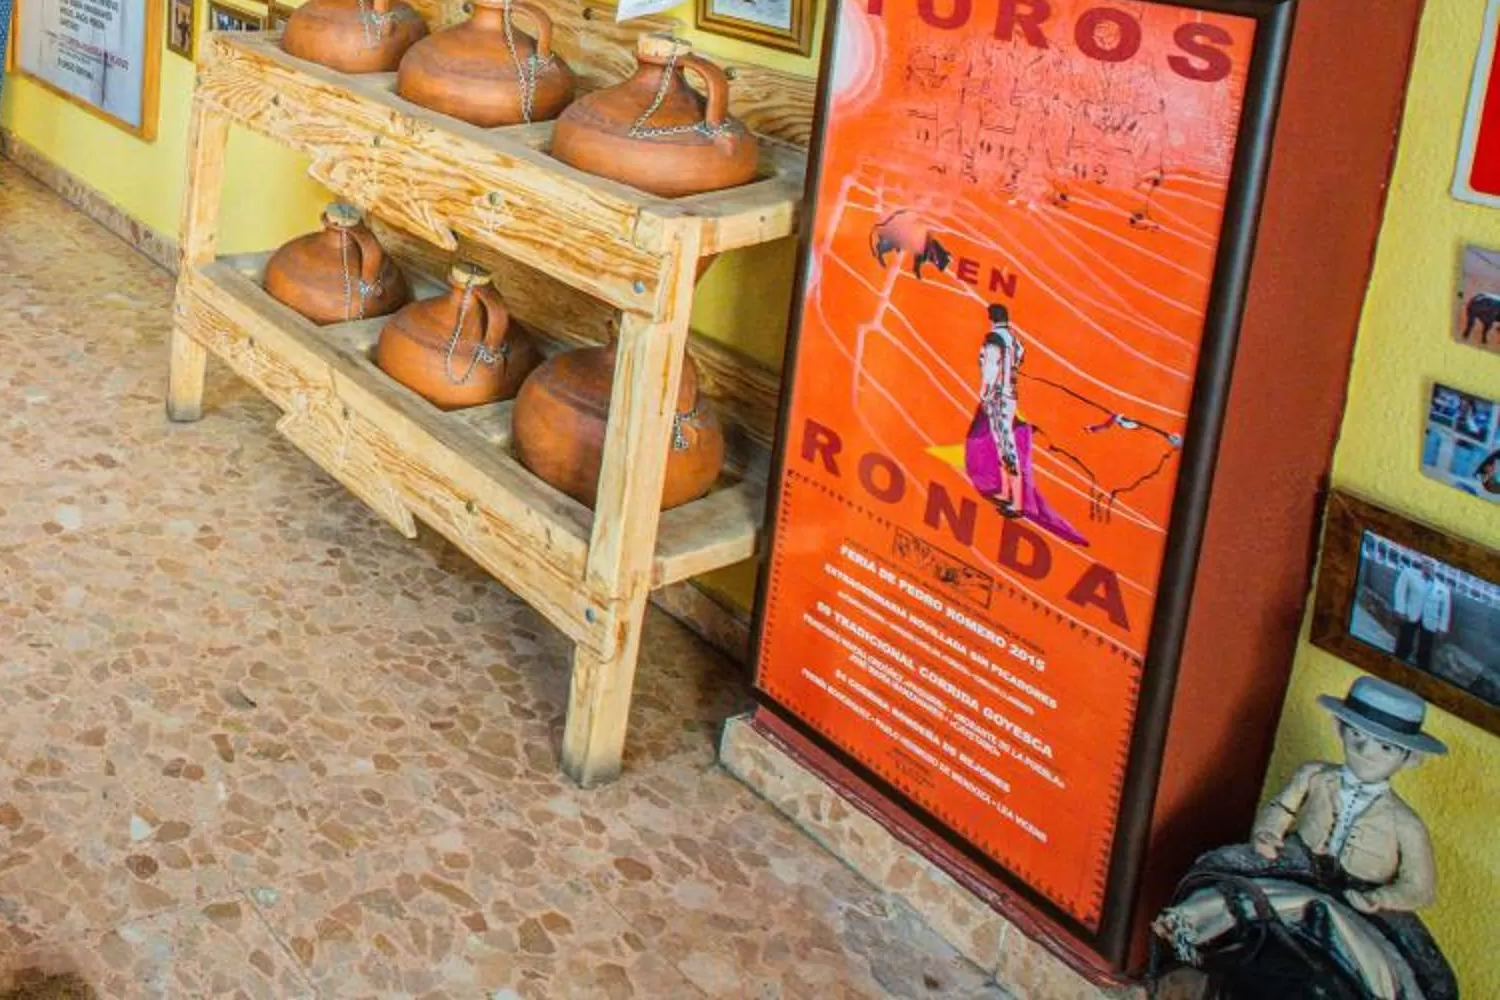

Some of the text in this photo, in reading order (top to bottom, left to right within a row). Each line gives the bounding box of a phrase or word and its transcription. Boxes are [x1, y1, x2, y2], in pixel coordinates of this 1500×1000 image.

[957, 256, 1017, 299] EN
[801, 418, 1131, 633] RONDA
[841, 543, 1046, 672] FERIA DE PEDRO ROMERO 2015
[833, 611, 916, 671] TRADICIONAL
[918, 666, 980, 711] CORRIDA
[982, 706, 1053, 759] GOYESCA
